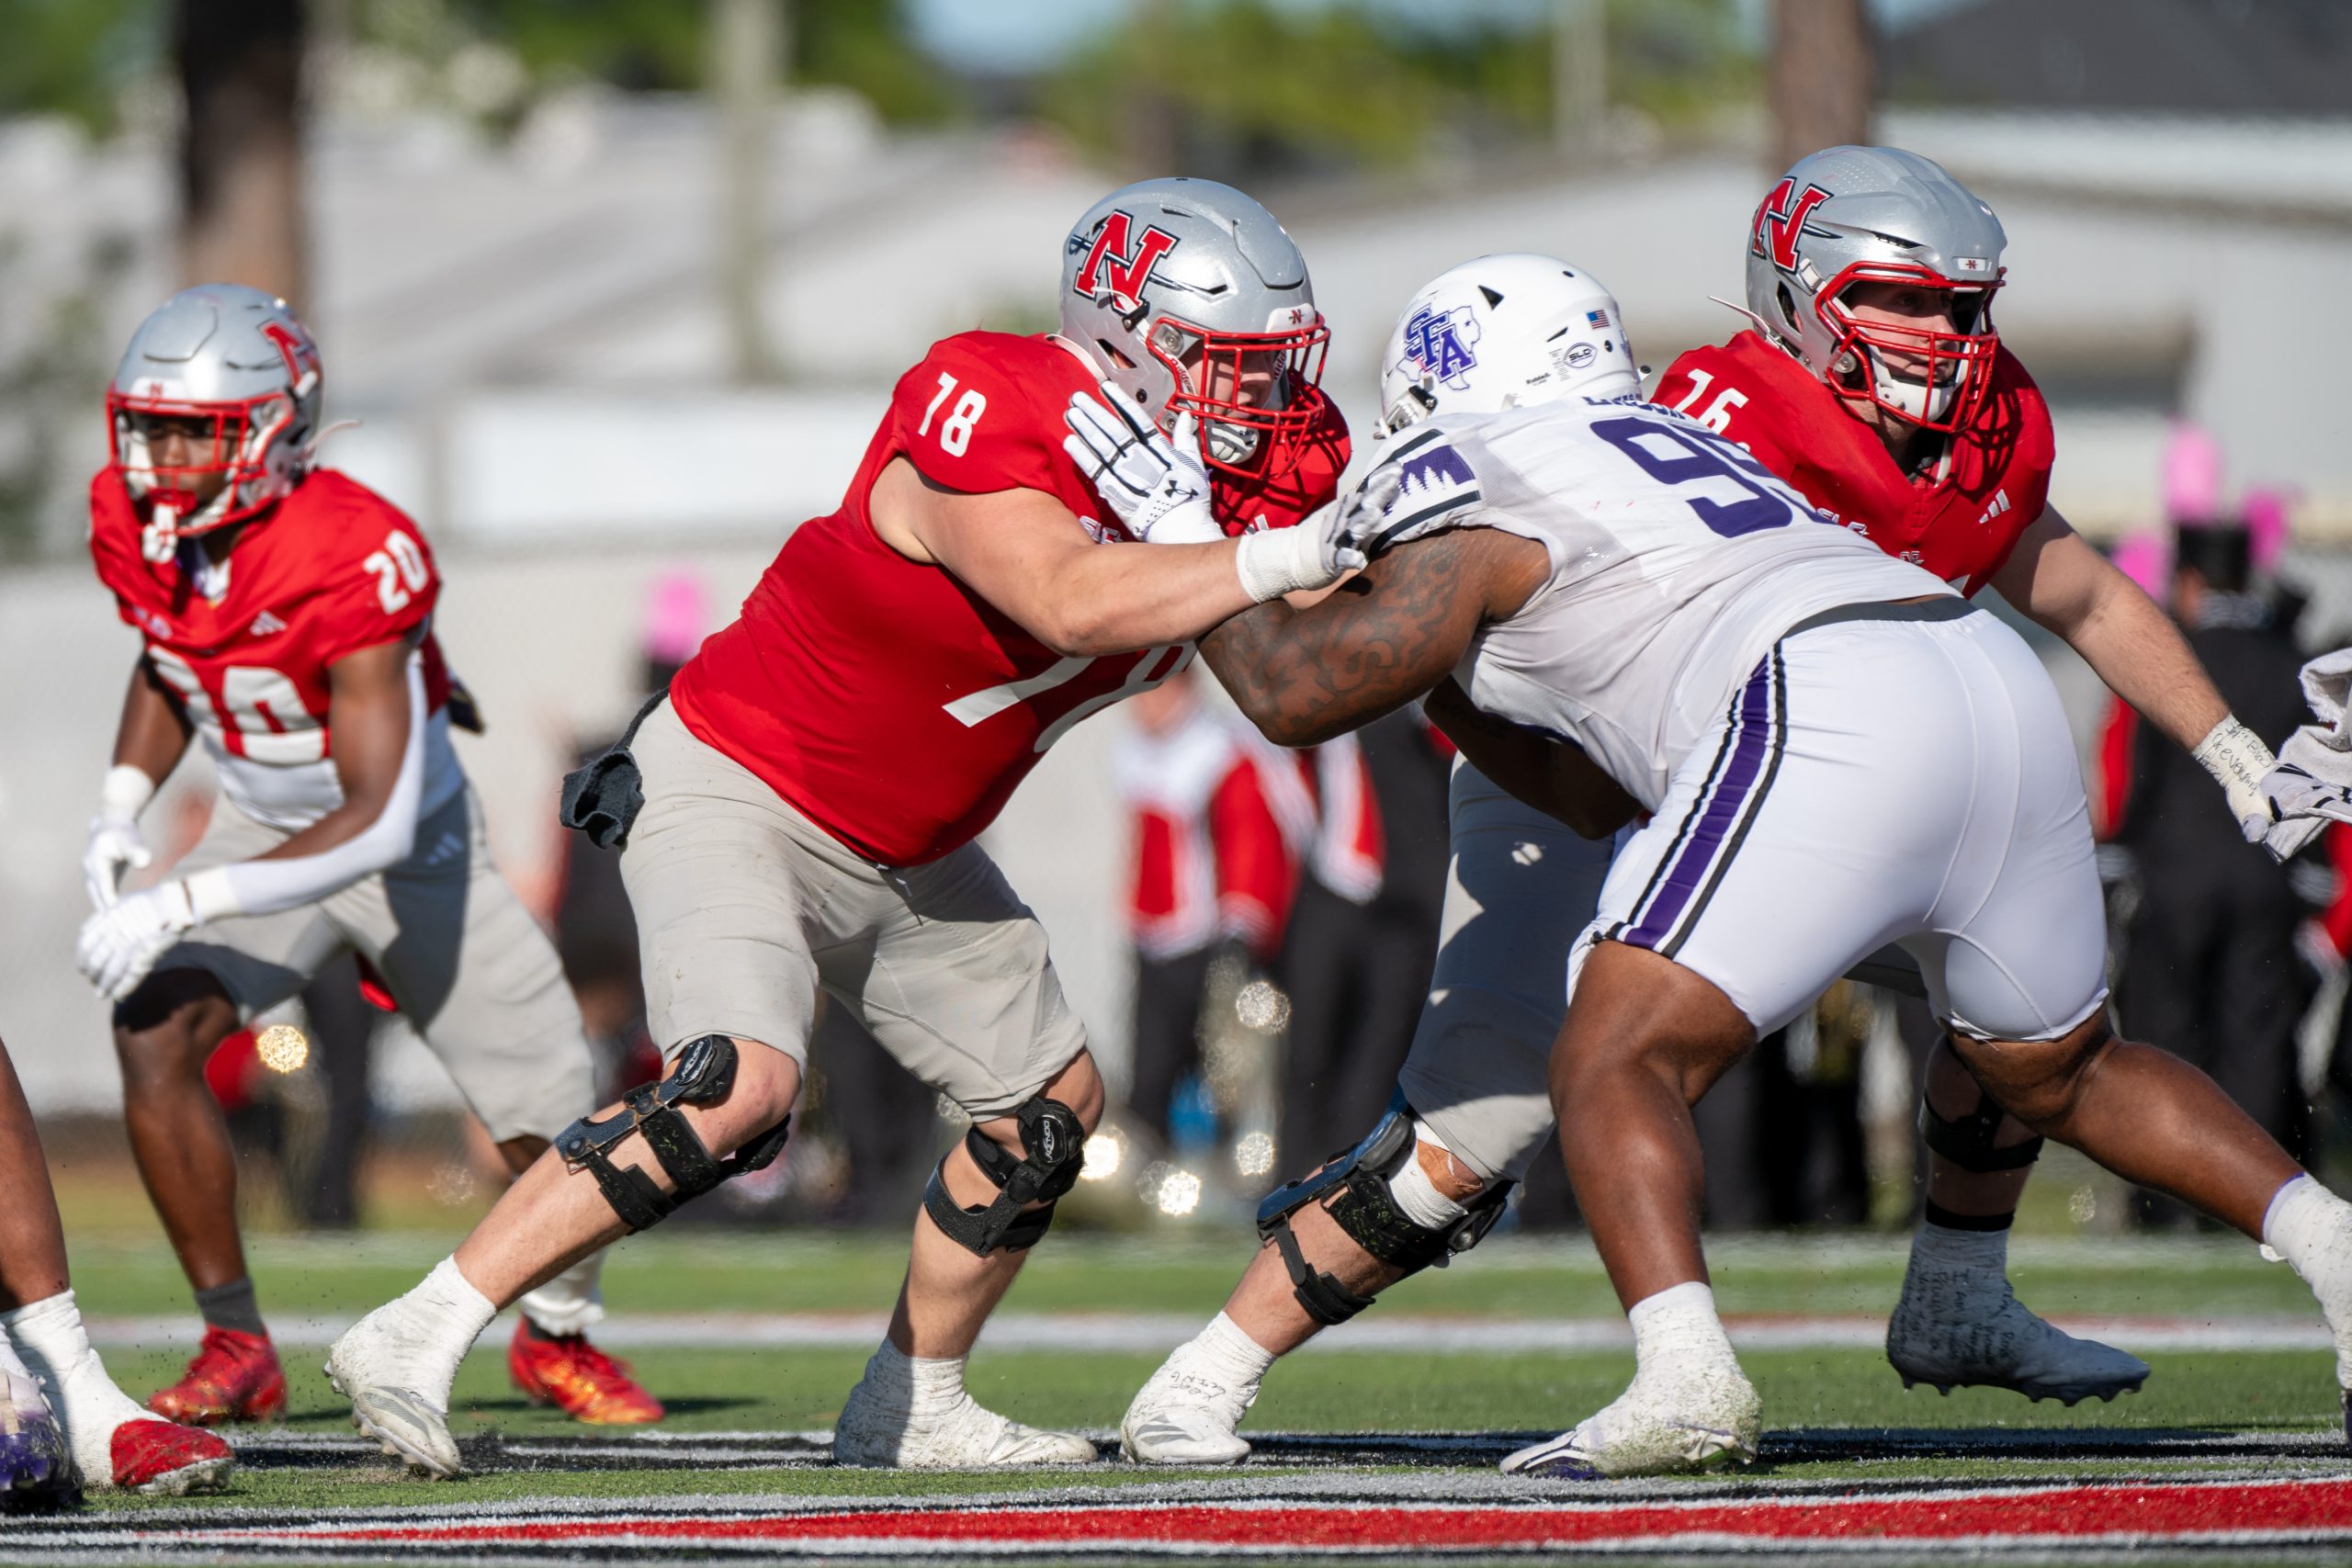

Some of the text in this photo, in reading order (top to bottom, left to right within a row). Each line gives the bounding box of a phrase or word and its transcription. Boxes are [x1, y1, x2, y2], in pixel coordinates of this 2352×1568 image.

[1073, 209, 1182, 315] N
[1751, 175, 1835, 275] N
[1403, 303, 1477, 383] SFA
[917, 371, 987, 457] 78
[1672, 368, 1749, 435] 76
[363, 528, 429, 615] 20
[1043, 1120, 1054, 1161] DONJOY
